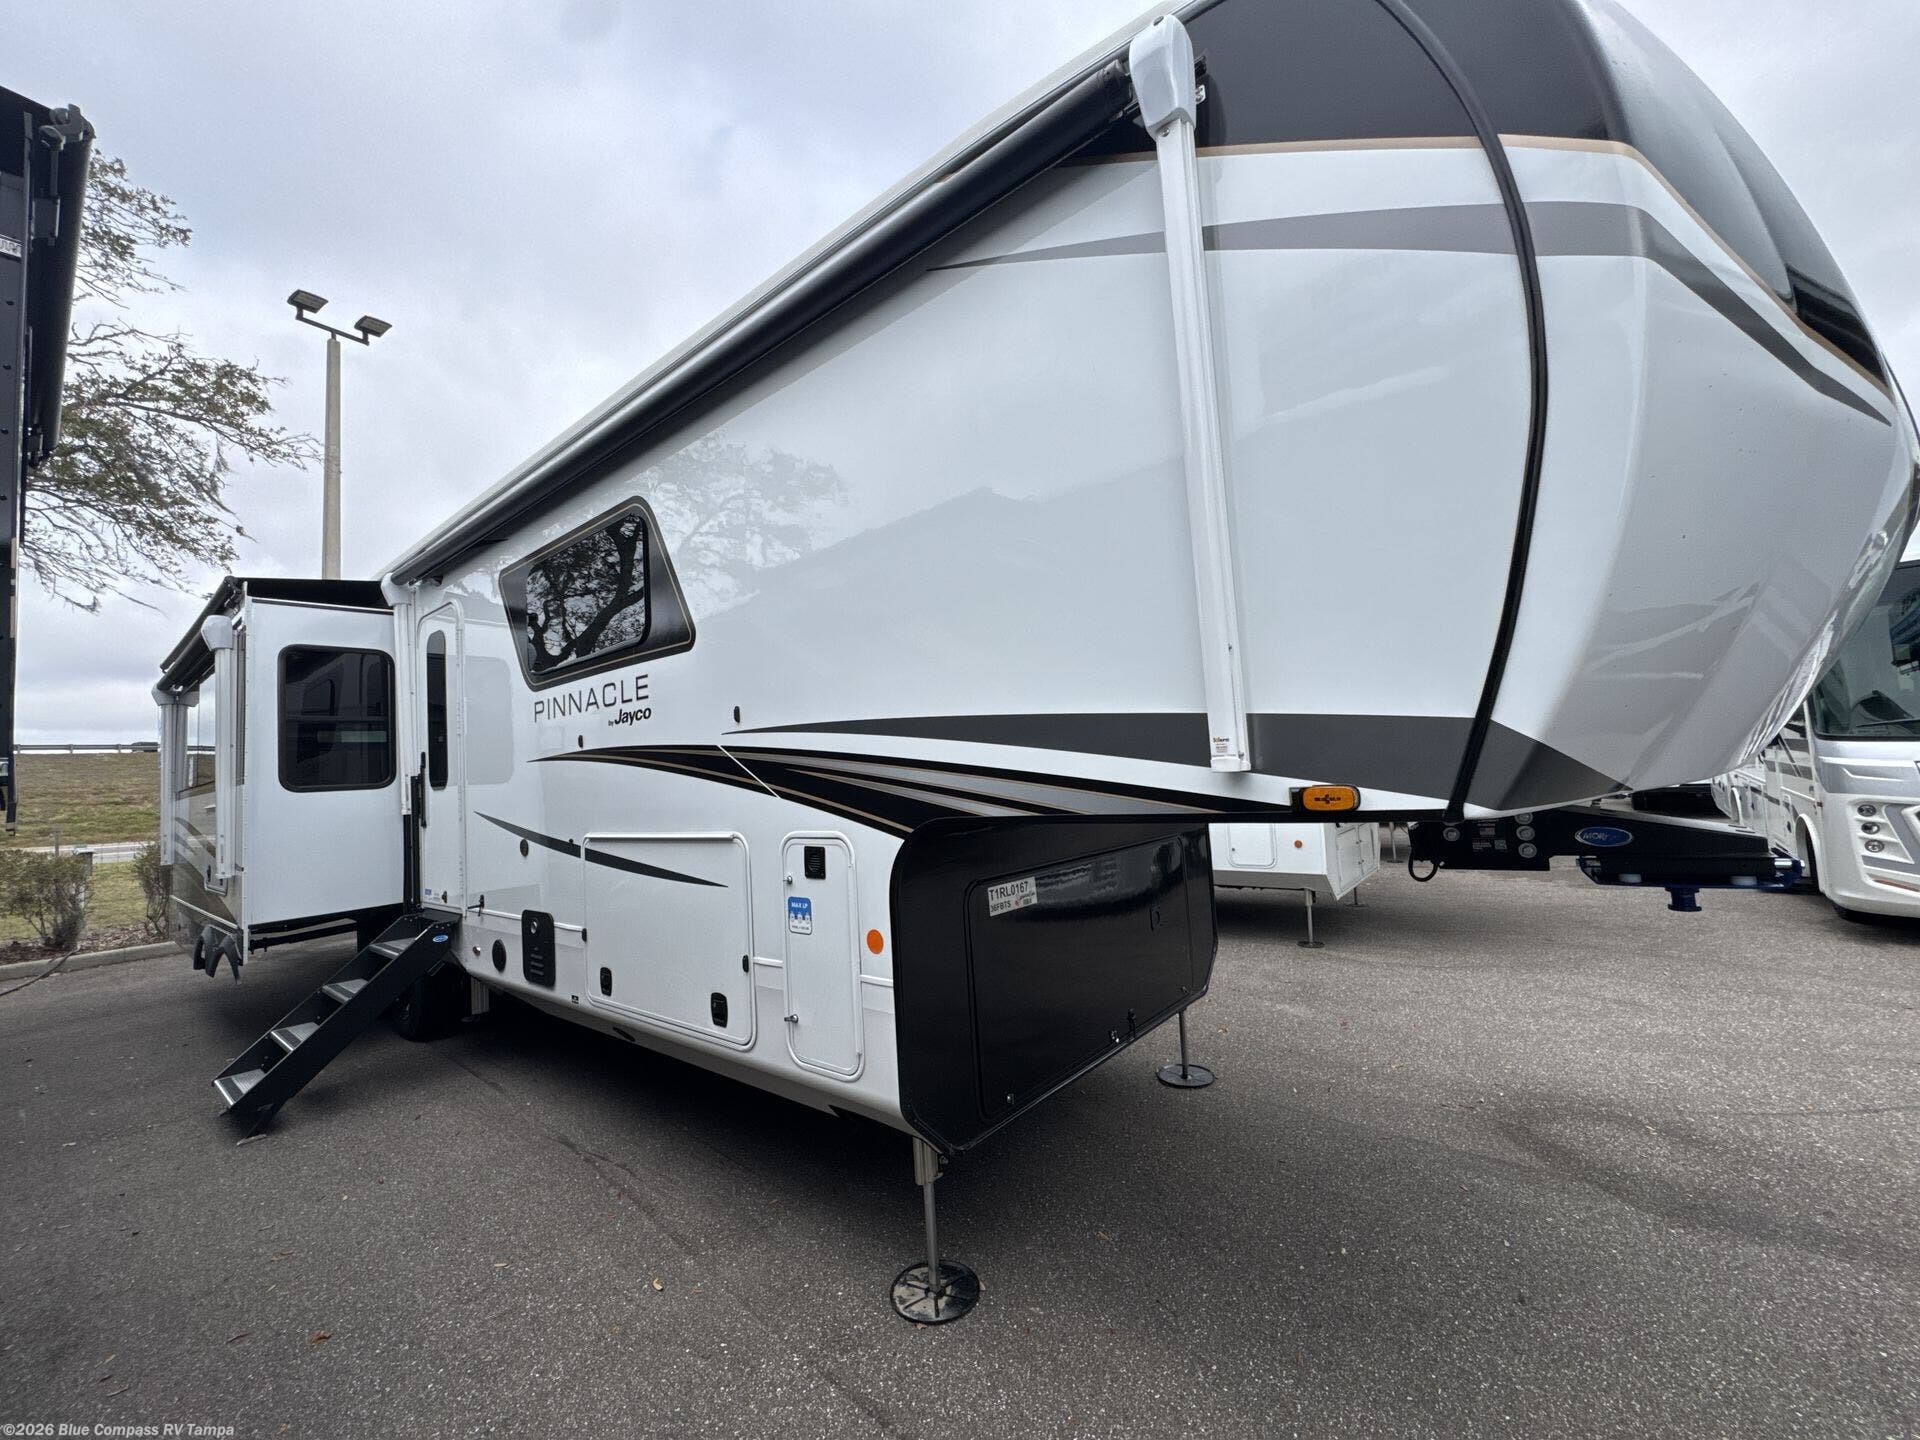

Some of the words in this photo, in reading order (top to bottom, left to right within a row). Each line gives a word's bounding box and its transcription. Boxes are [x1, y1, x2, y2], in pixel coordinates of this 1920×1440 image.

[534, 674, 649, 723] PINNACLE
[608, 719, 614, 727] by
[614, 707, 651, 725] Jayco
[988, 881, 1028, 901] T1RL0167
